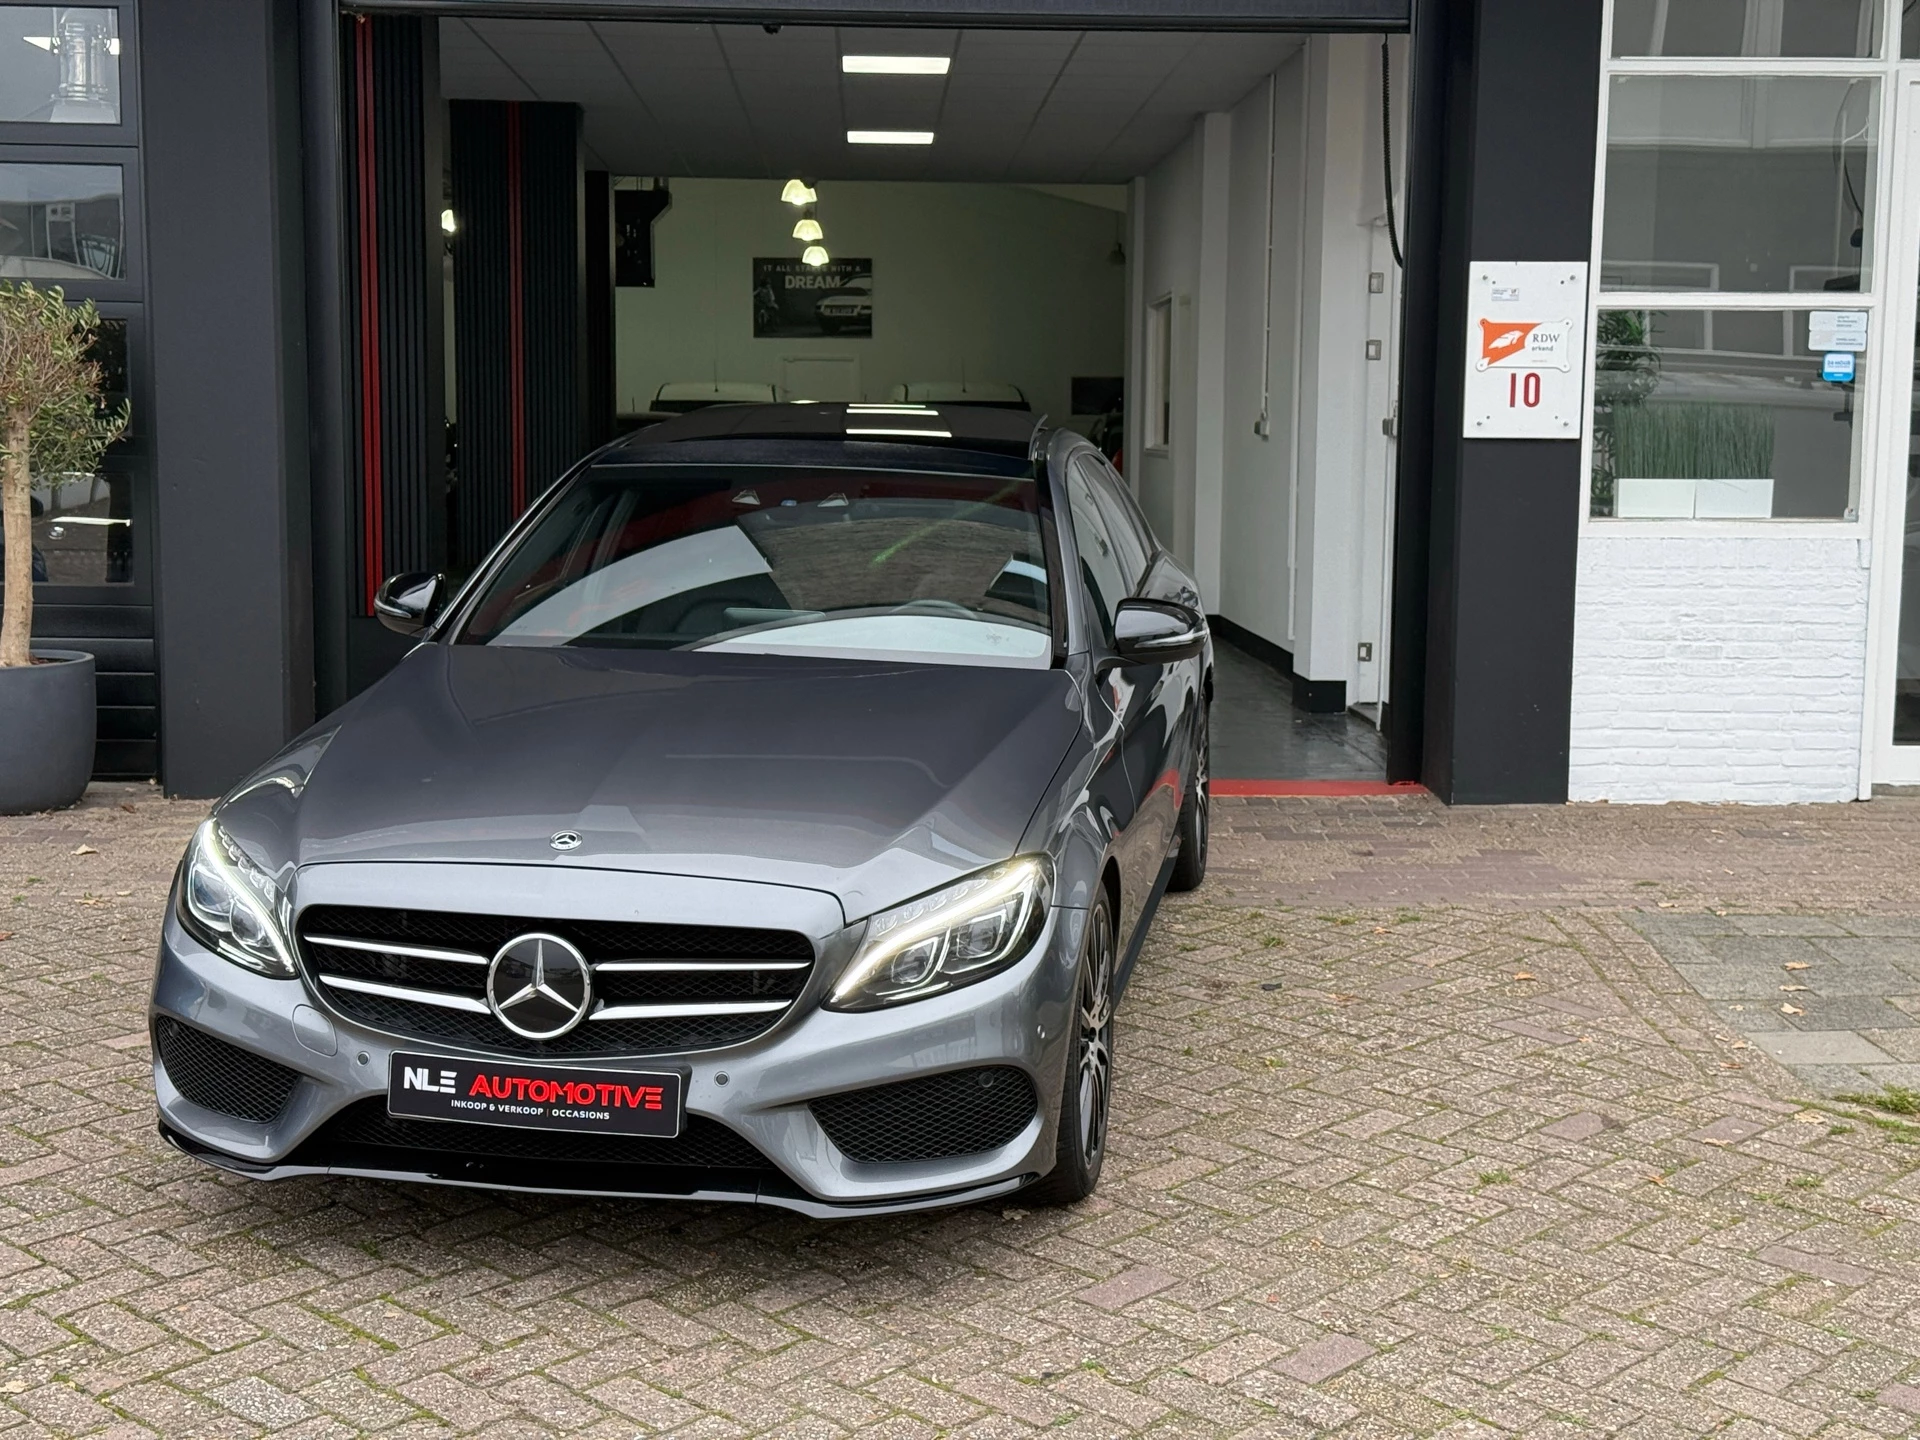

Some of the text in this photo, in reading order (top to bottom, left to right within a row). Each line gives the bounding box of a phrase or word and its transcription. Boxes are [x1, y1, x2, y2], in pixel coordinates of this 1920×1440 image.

[784, 275, 841, 289] DREAM
[1532, 333, 1561, 343] RDW
[1509, 373, 1541, 408] 10
[403, 1066, 663, 1110] NLE AUTOMOTIVE
[450, 1099, 610, 1120] INKOOP & VERKOOP OCCASIONS
